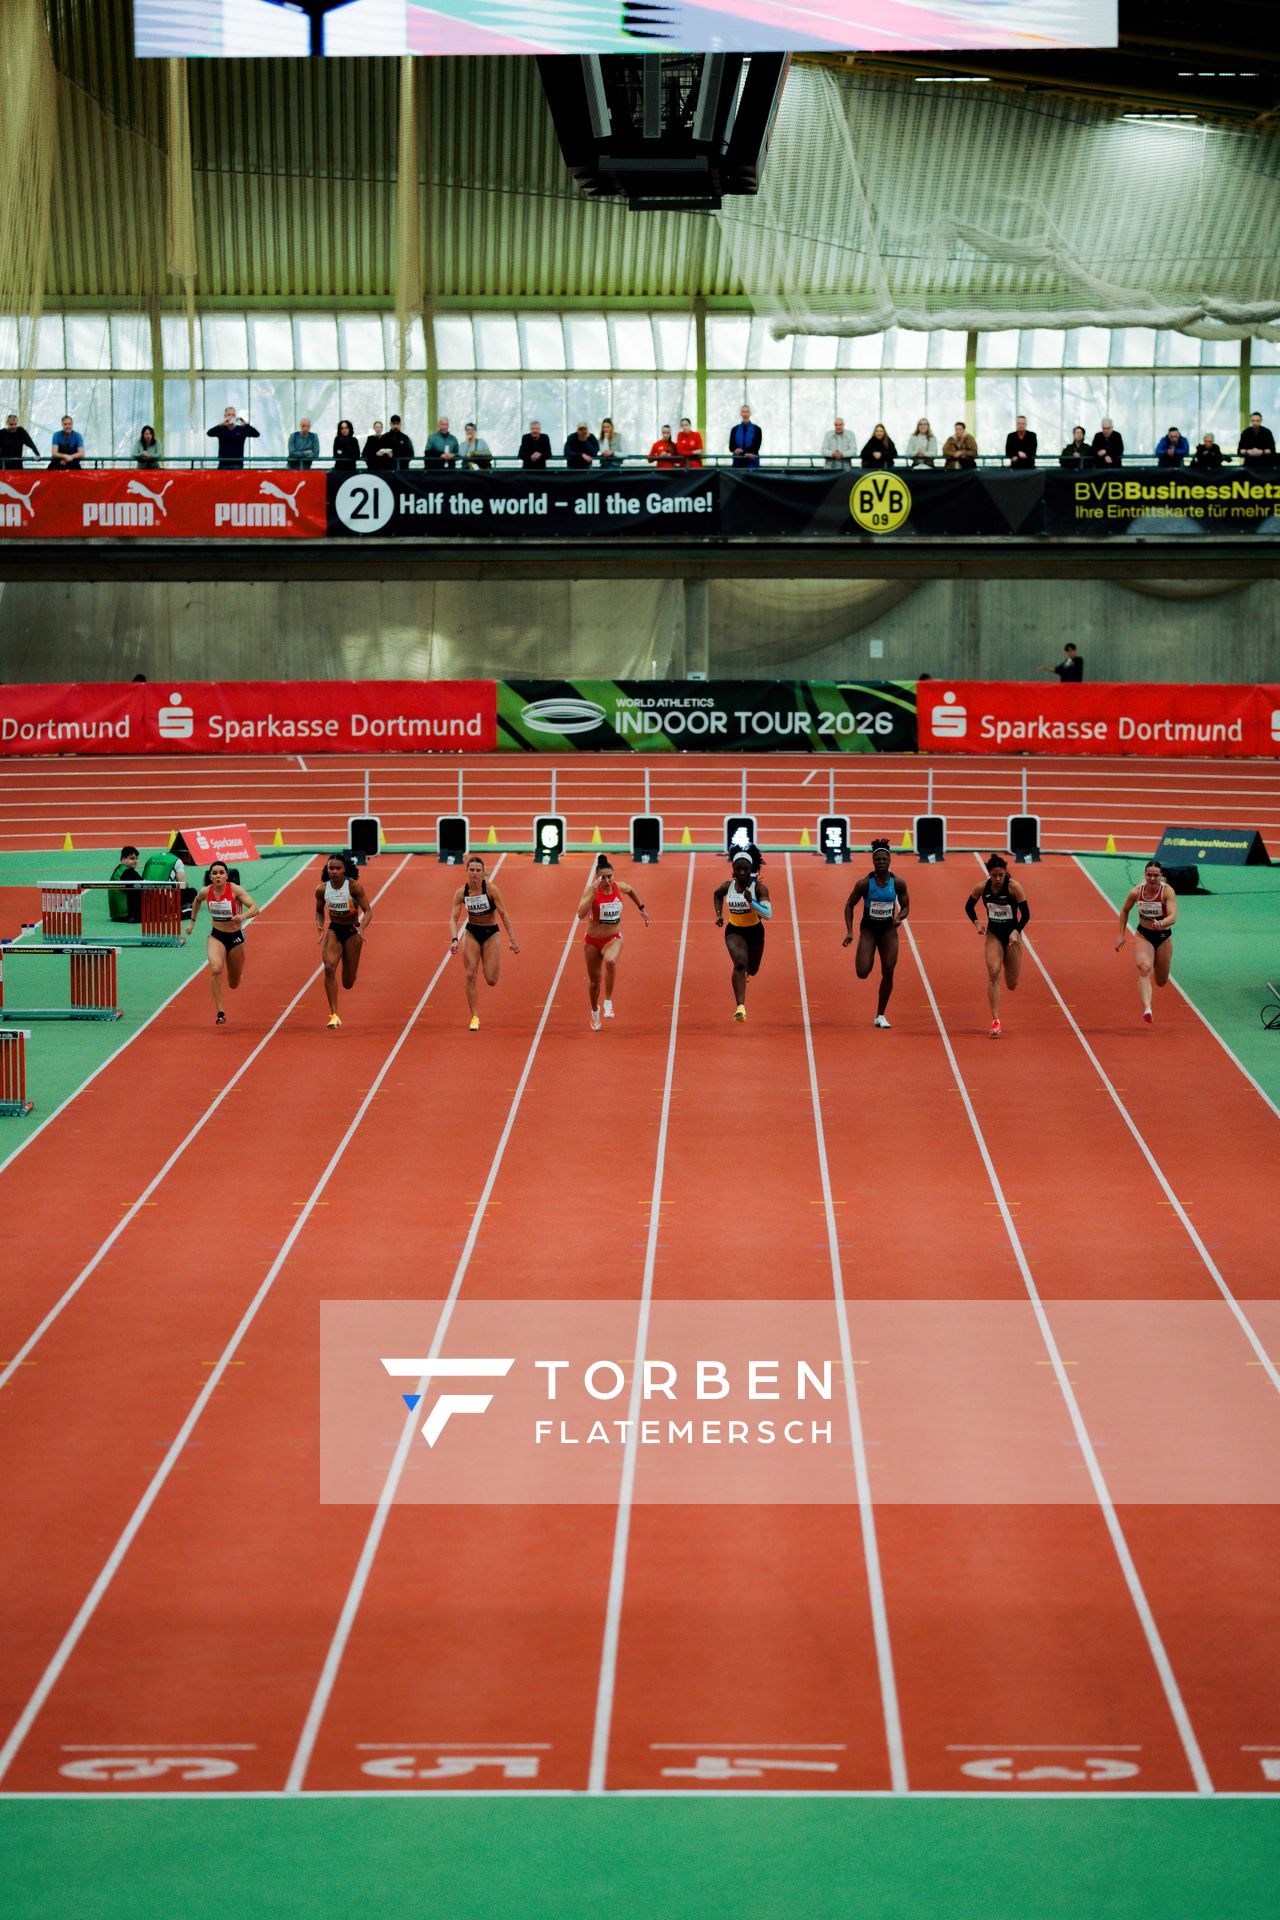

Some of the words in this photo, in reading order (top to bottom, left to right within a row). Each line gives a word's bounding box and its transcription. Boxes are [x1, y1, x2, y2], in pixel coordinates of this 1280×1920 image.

[400, 493, 443, 515] Half
[449, 494, 483, 515] the
[490, 493, 548, 515] world
[574, 493, 600, 515] all
[606, 493, 640, 514] the
[646, 492, 713, 514] Game!
[860, 479, 903, 513] BVB
[83, 503, 154, 526] PUMA
[215, 503, 286, 526] PUMA
[872, 514, 889, 526] 09
[1075, 505, 1104, 518] Ihre
[1107, 504, 1204, 518] Eintrittskarte
[1208, 503, 1228, 518] für
[1231, 504, 1270, 518] mehr
[616, 698, 656, 708] WORLD
[656, 698, 714, 708] ATHLETICS
[2, 715, 130, 741] Dortmund
[208, 714, 339, 743] Sparkasse
[351, 713, 482, 737] Dortmund
[615, 711, 727, 734] INDOOR
[734, 711, 811, 734] TOUR
[818, 711, 893, 734] 2026
[980, 715, 1107, 744] Sparkasse
[1119, 717, 1243, 742] Dortmund
[361, 1756, 540, 1779] 5
[660, 1756, 839, 1780] 4
[960, 1757, 1140, 1781] 3
